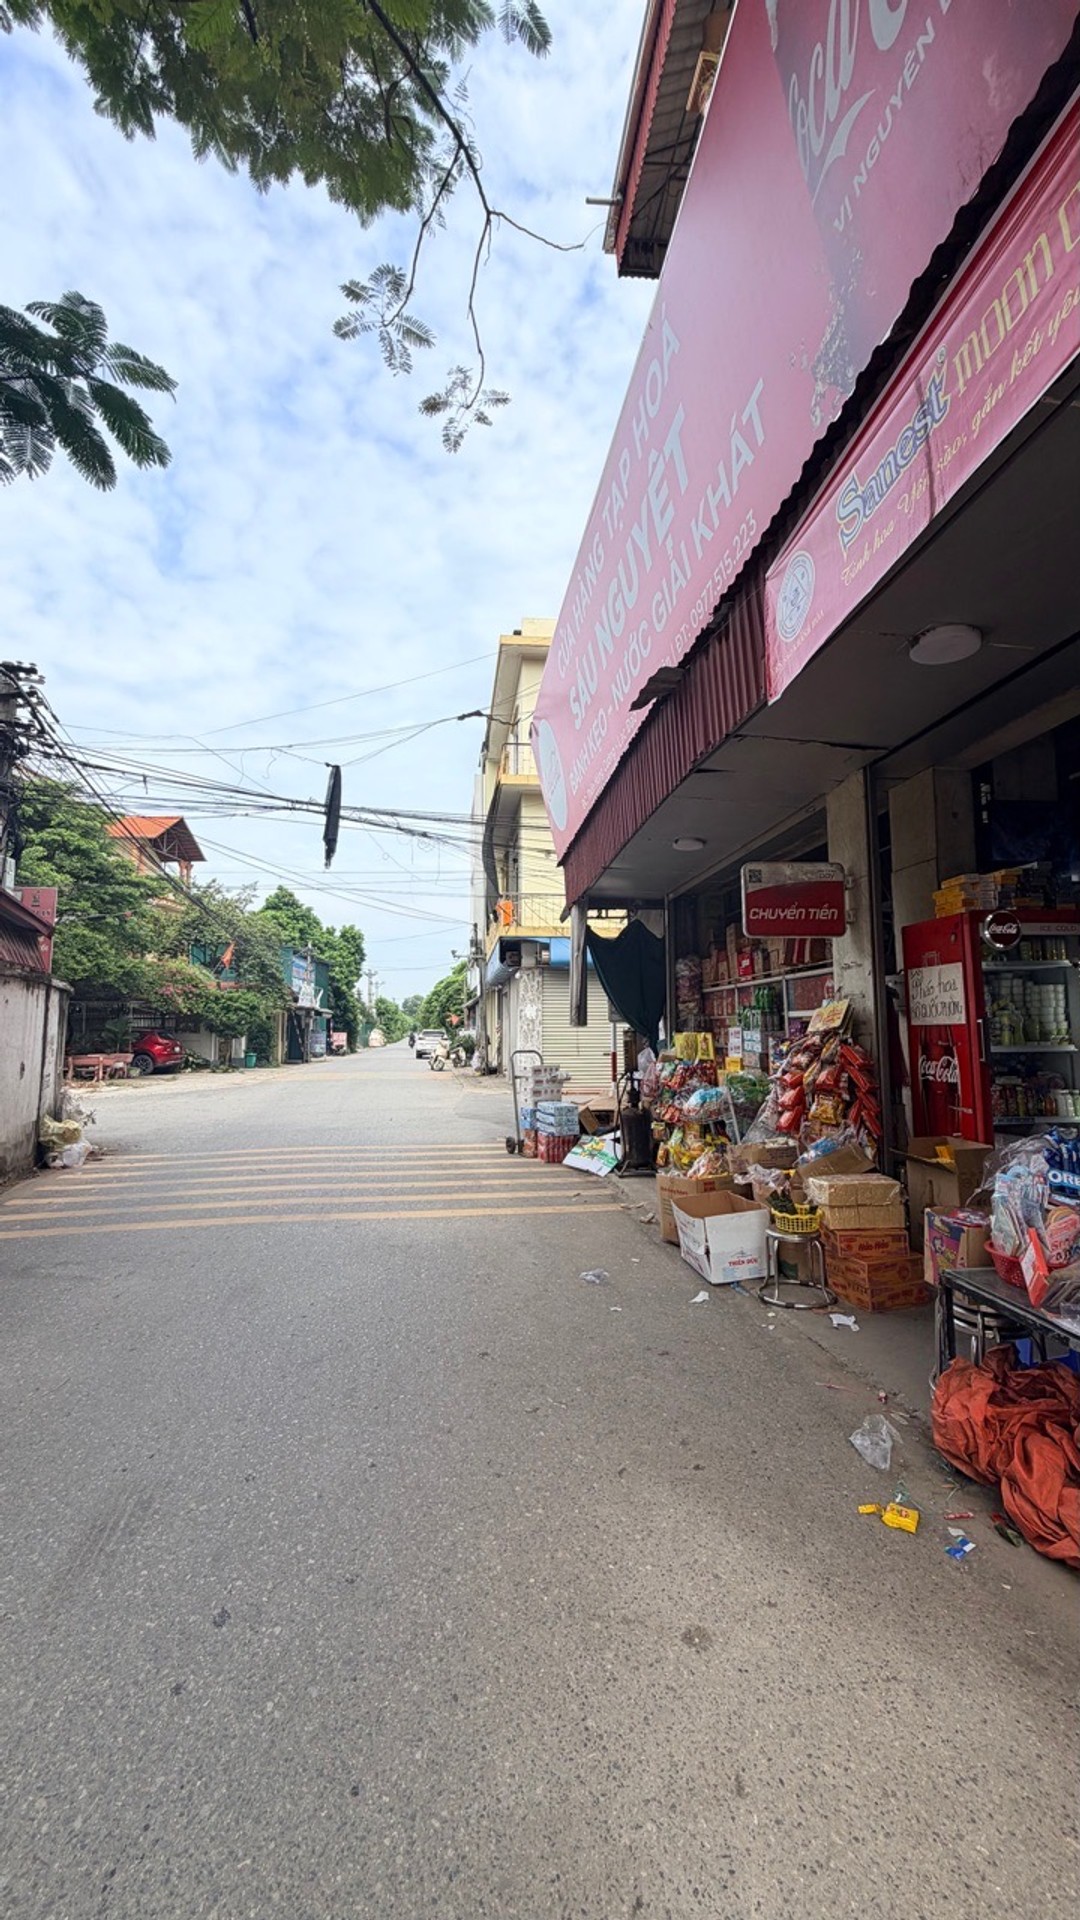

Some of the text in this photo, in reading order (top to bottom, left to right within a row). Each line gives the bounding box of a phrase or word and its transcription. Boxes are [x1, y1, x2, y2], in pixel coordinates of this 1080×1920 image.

[853, 16, 935, 198] NGUYÊN
[569, 640, 598, 730] SÁU
[595, 401, 689, 670] NGUYỆT
[572, 531, 605, 625] HÀNG
[602, 447, 630, 540] TẠP
[632, 301, 680, 460] HOÁ
[610, 619, 652, 711] NƯỚC
[652, 533, 692, 632] GIẢI
[690, 377, 765, 561] KHÁT
[690, 508, 757, 629] 0977.515.223
